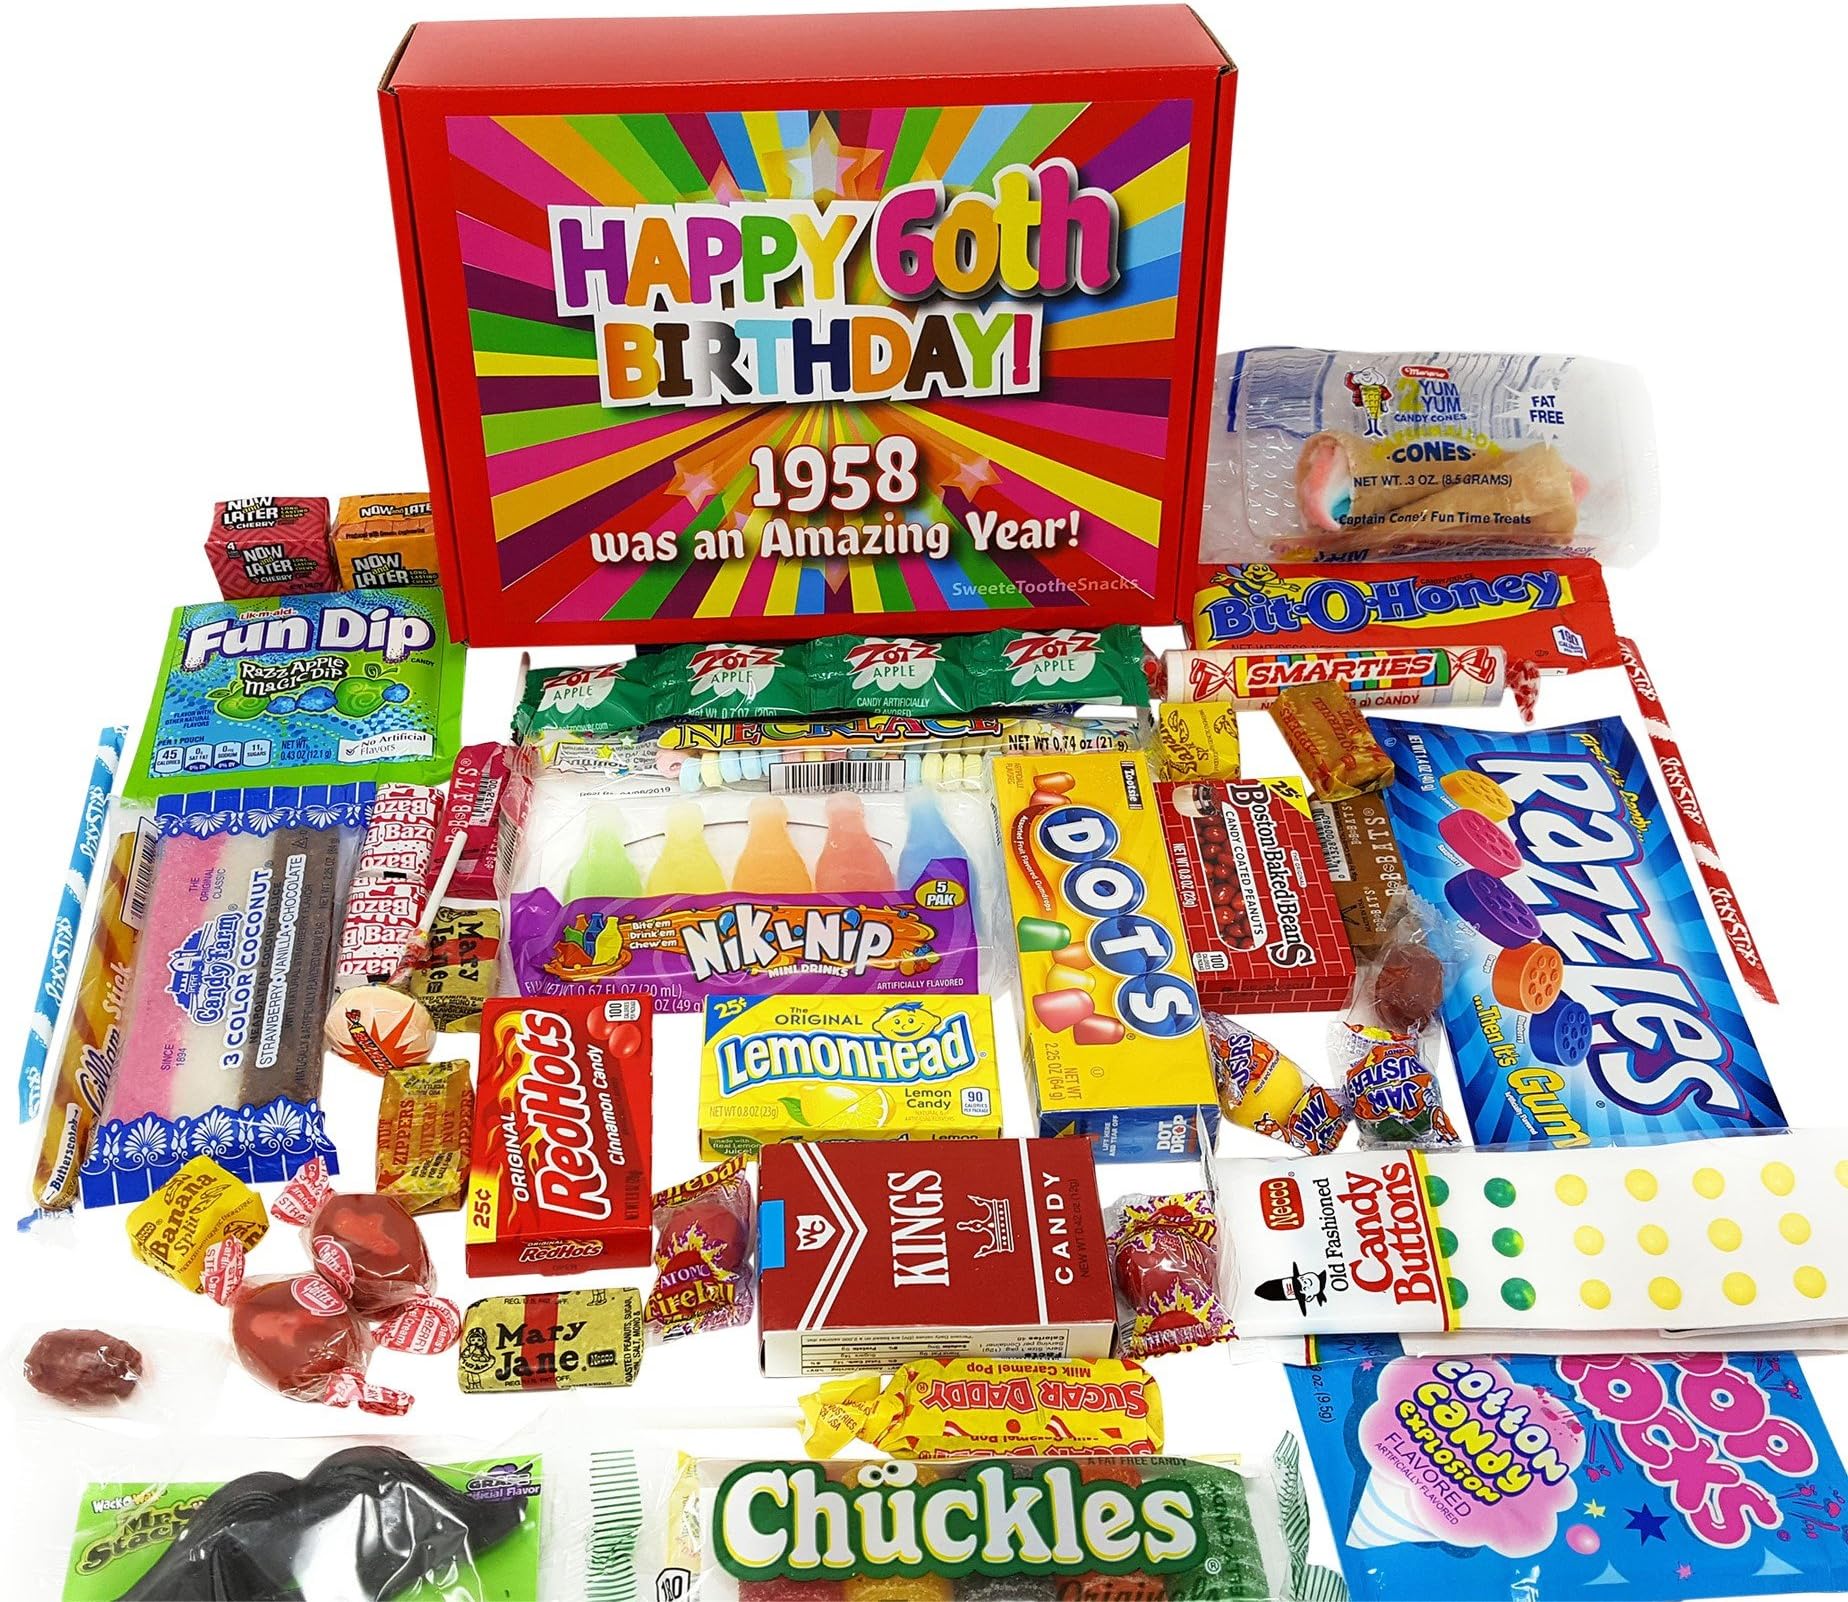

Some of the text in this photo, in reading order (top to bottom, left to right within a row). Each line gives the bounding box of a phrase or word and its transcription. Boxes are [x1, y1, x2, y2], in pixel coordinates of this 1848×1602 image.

[559, 165, 1111, 308] HAPPY 60th
[604, 313, 1033, 400] BIRTHDAY!
[1419, 380, 1459, 397] YUM
[1531, 396, 1556, 408] FAT
[1394, 412, 1468, 423] CANDY CONES
[1422, 396, 1462, 413] YUM
[1529, 409, 1565, 425] FREE
[1391, 441, 1472, 464] CONES
[750, 435, 918, 512] 1958
[1354, 474, 1513, 488] NET WT. OZ. GRAMS)
[223, 507, 279, 525] LATER
[361, 505, 392, 517] NOW
[1338, 511, 1531, 526] Captain Cone's Fun Time Treats
[236, 521, 276, 529] CHERRY
[590, 510, 1081, 563] was an Amazing Year!
[243, 545, 283, 562] NOW
[354, 554, 399, 571] NOW
[246, 559, 293, 577] LATER
[260, 575, 292, 583] CHERRY
[355, 569, 410, 588] LATER
[952, 576, 1139, 598] SweeteTootheSnacks
[185, 607, 432, 666] Fun Dip
[845, 641, 944, 674] ZOTZ
[1002, 632, 1103, 671] ZOTZ
[544, 662, 625, 689] ZOTZ
[688, 649, 785, 682] ZOTZ
[711, 671, 753, 684] APPLE
[873, 664, 916, 678] APPLE
[1033, 659, 1075, 673] APPLE
[1247, 656, 1432, 685] SMARTIES
[553, 686, 593, 701] APPLE
[857, 697, 930, 707] CANDY ARTIFICIALLY
[1375, 694, 1420, 706] CANDY
[360, 743, 396, 756] Flavors
[361, 733, 426, 748] No Artificial
[1009, 735, 1114, 751] NET WT 0.74 oz (21
[161, 750, 177, 760] 45
[1123, 769, 1140, 804] Tootsie
[1270, 780, 1303, 800] 25¢
[1226, 783, 1277, 848] Boston
[200, 867, 214, 902] ORIGINAL
[213, 868, 226, 900] CLASSIC
[1019, 856, 1052, 913] Flavored Gumdrops
[1225, 810, 1264, 935] CANDY COATED PEANUTS
[1263, 848, 1291, 900] Baked
[926, 893, 956, 907] PAK
[936, 881, 948, 893] 5
[1047, 815, 1194, 1024] DOTS
[1269, 900, 1316, 967] BeanS
[1477, 757, 1742, 1110] Razzles
[259, 983, 281, 1066] STRAWBERRY
[274, 934, 291, 978] VANILLA
[283, 857, 304, 923] CHOCOLATE
[458, 921, 485, 982] Mary
[224, 870, 269, 1068] 3 COLOR COCONUT
[768, 966, 849, 978] MINI DRINKS
[103, 961, 130, 1020] Stick
[877, 978, 964, 990] ARTIFICIALLY FLAVORED
[608, 1002, 622, 1019] 100
[655, 999, 691, 1013] OZ (49
[714, 997, 748, 1020] 25¢
[775, 1015, 863, 1026] ORIGINAL
[161, 1044, 174, 1071] SINCE
[175, 1047, 187, 1067] 1894
[1044, 1043, 1060, 1062] 2.25
[905, 1088, 952, 1098] Lemon
[968, 1091, 983, 1102] 90
[1064, 1067, 1082, 1100] NET WT
[587, 1044, 625, 1166] Cinnamon Candy
[906, 1098, 952, 1110] Candy
[1367, 1081, 1418, 1115] JAW
[1507, 1066, 1592, 1150] Gum
[521, 1011, 611, 1220] RedHots
[759, 1106, 779, 1118] (23g)
[392, 1099, 415, 1166] ZIPPERS
[1157, 1121, 1173, 1150] DOT
[49, 1116, 79, 1191] Butterscotch
[500, 1111, 530, 1203] ORIGINAL
[474, 1188, 492, 1229] 25¢
[1268, 1180, 1300, 1227] Necco
[151, 1173, 217, 1262] Banana
[887, 1170, 950, 1288] KINGS
[1042, 1171, 1074, 1285] CANDY
[173, 1212, 201, 1257] Split
[1312, 1177, 1349, 1292] Old Fashioned
[1337, 1170, 1394, 1293] Candy
[1381, 1161, 1437, 1305] Buttons
[519, 1243, 603, 1263] RedHots
[495, 1320, 587, 1351] Mary
[967, 1364, 1091, 1377] Milk Caramel Pop
[922, 1377, 1037, 1411] DADDY
[1040, 1380, 1149, 1418] SUGAR
[1313, 1391, 1336, 1423] (9.5g)
[1098, 1457, 1187, 1466] FAT FREE CANDY
[1384, 1431, 1472, 1519] FLAVORED
[506, 1486, 541, 1497] Flavor
[1374, 1442, 1460, 1526] ARTIFICIALLY FLAVORED
